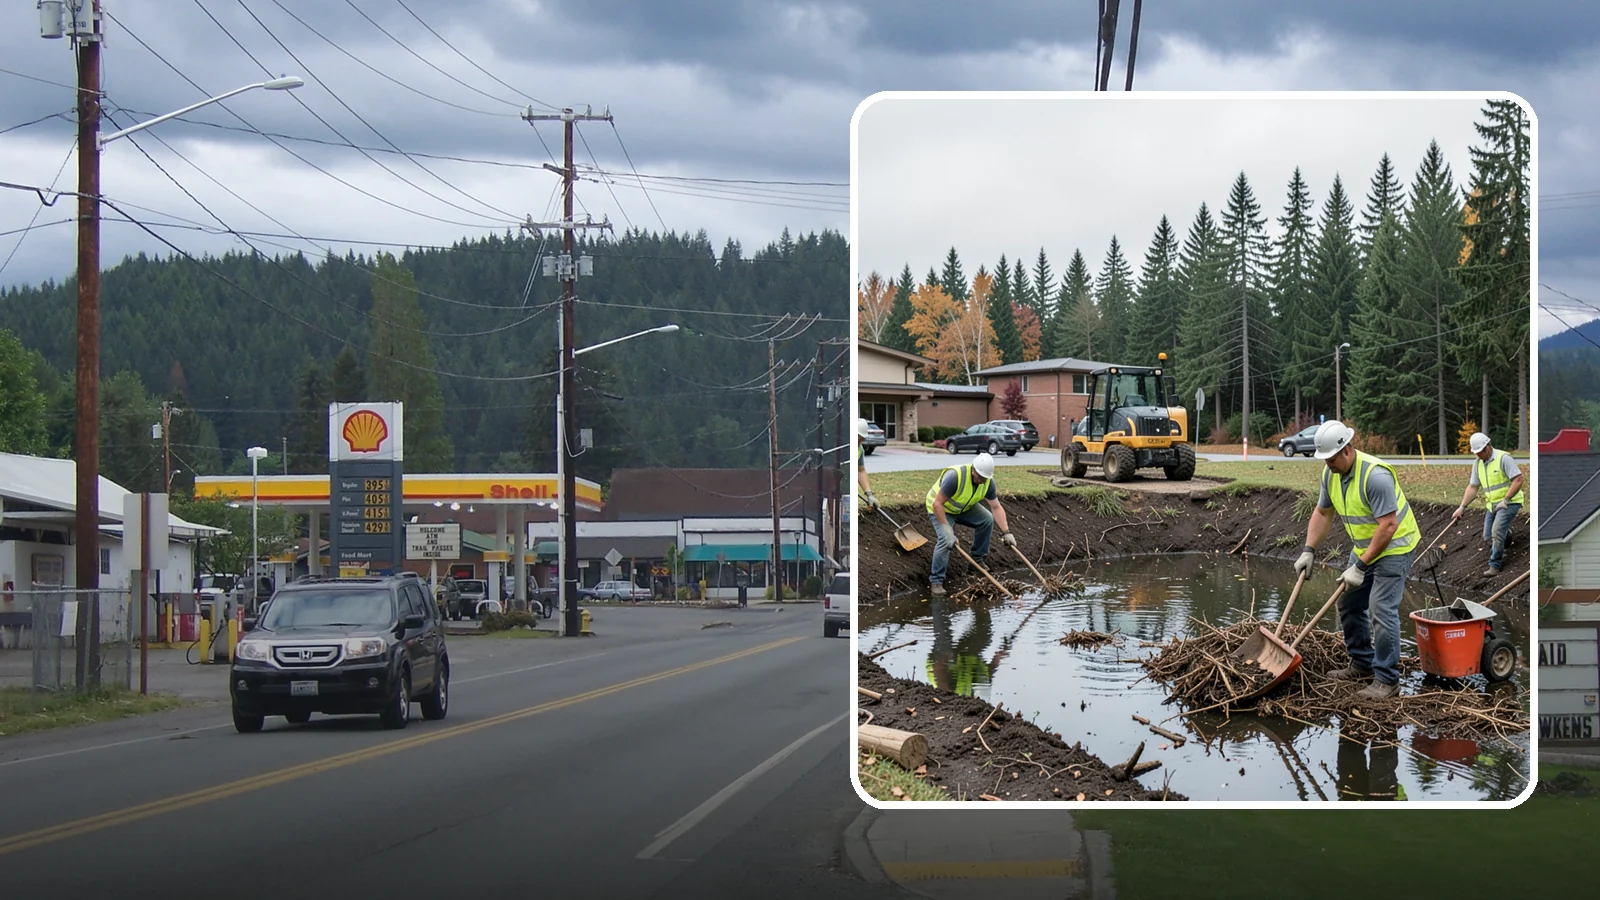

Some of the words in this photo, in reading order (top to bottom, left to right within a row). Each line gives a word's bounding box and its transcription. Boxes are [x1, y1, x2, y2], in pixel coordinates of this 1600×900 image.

[365, 480, 383, 490] 395
[490, 484, 547, 499] Shell
[365, 494, 383, 504] 405
[365, 508, 383, 518] 415
[365, 522, 383, 532] 429
[1538, 642, 1566, 665] AID
